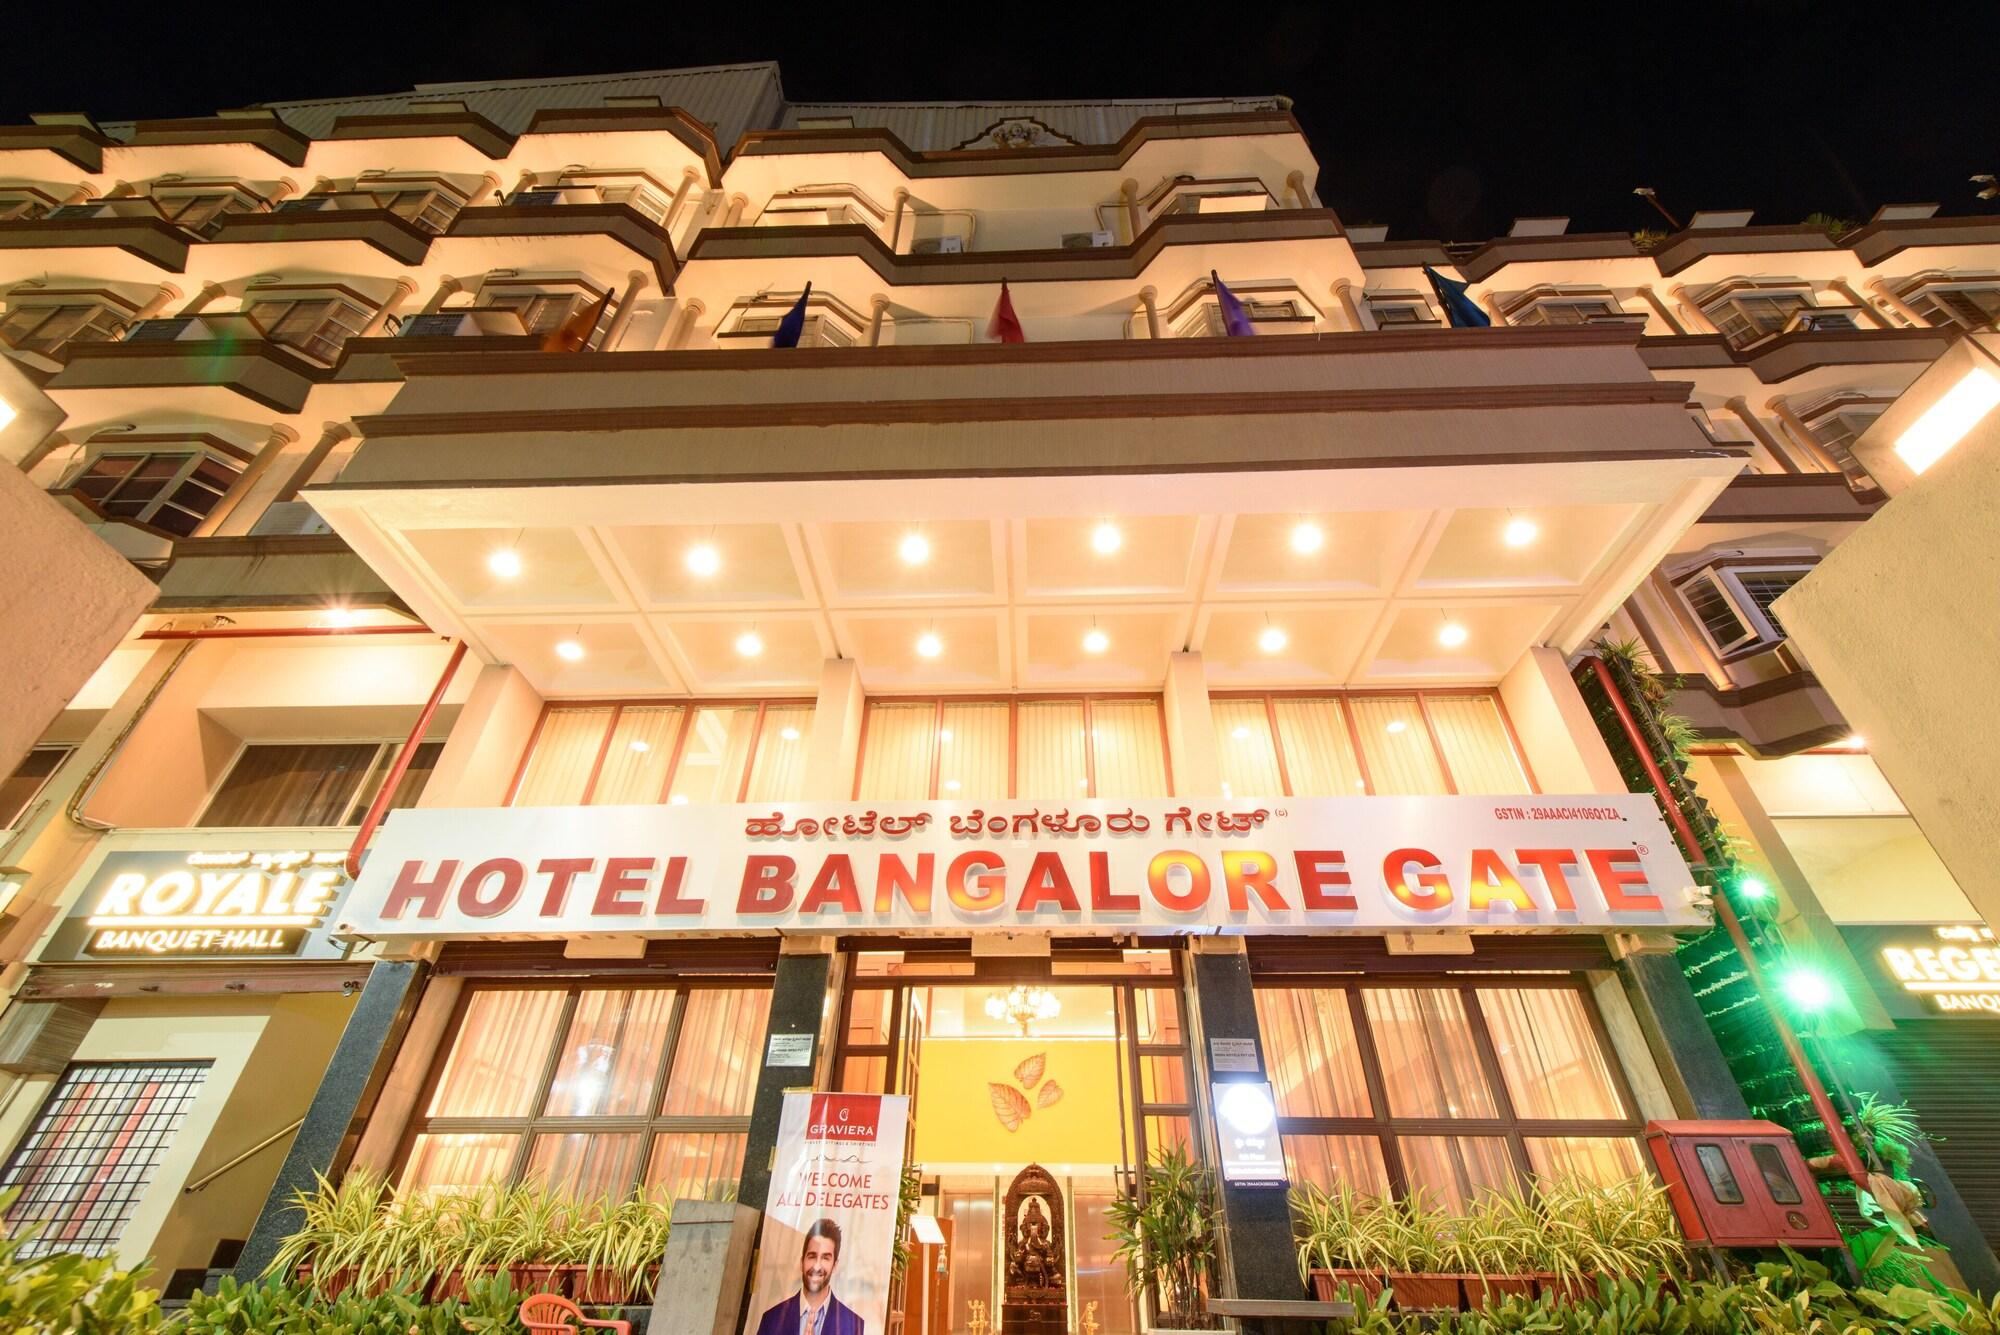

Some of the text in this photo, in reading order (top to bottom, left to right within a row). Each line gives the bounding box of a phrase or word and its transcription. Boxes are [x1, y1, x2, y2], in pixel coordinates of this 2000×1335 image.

[745, 810, 932, 837] ಹೋಟೆಲ್
[950, 807, 1150, 834] ಬೆಂಗಳೂರು
[1165, 806, 1271, 833] ಗೇಟ್
[1494, 807, 1525, 820] GSTIN
[96, 871, 337, 915] ROYALE
[379, 856, 706, 919] HOTEL
[735, 849, 1359, 914] BANGALORE
[1382, 848, 1664, 912] GATE
[95, 929, 284, 952] BANQUET HALL
[809, 1124, 874, 1136] GRAVIERA
[804, 1192, 889, 1210] DELEGATES
